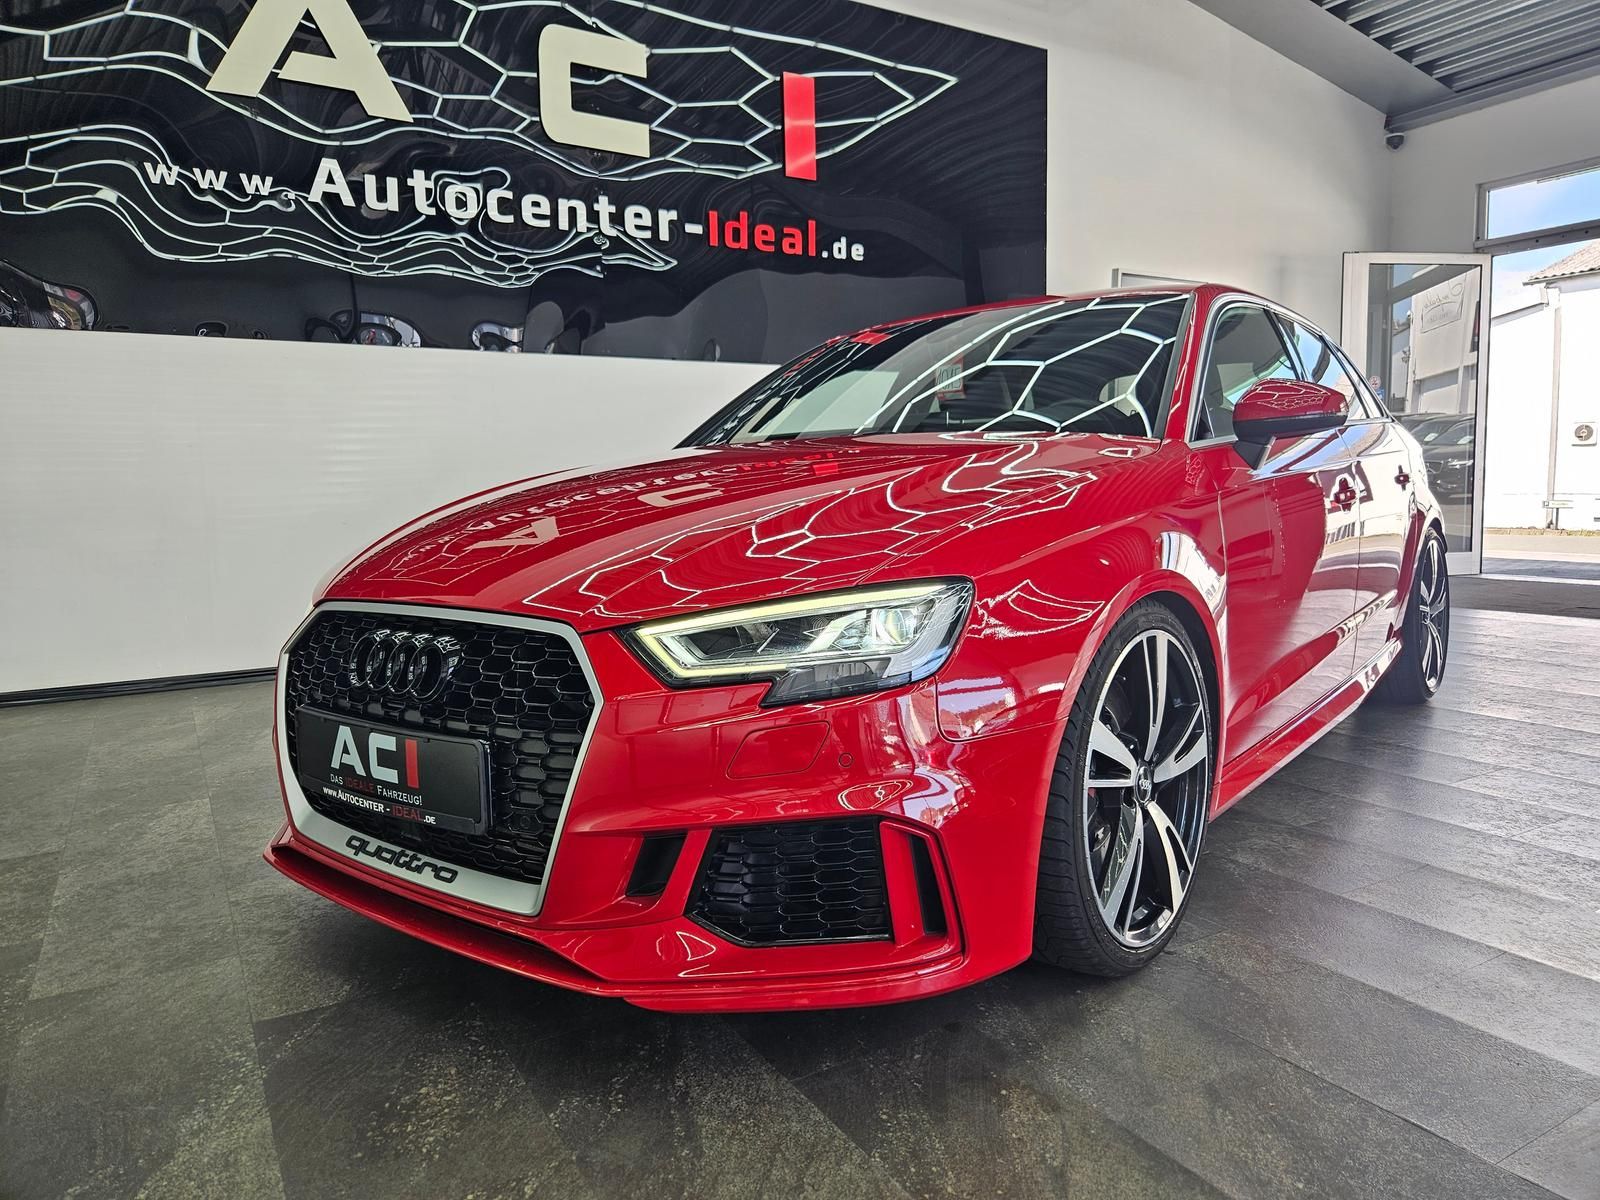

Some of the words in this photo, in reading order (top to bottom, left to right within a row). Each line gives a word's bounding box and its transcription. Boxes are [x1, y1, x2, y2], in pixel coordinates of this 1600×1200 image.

[330, 725, 419, 788] ACI
[330, 774, 344, 785] DAS
[345, 778, 375, 793] IDEALE
[345, 835, 459, 883] quattro
